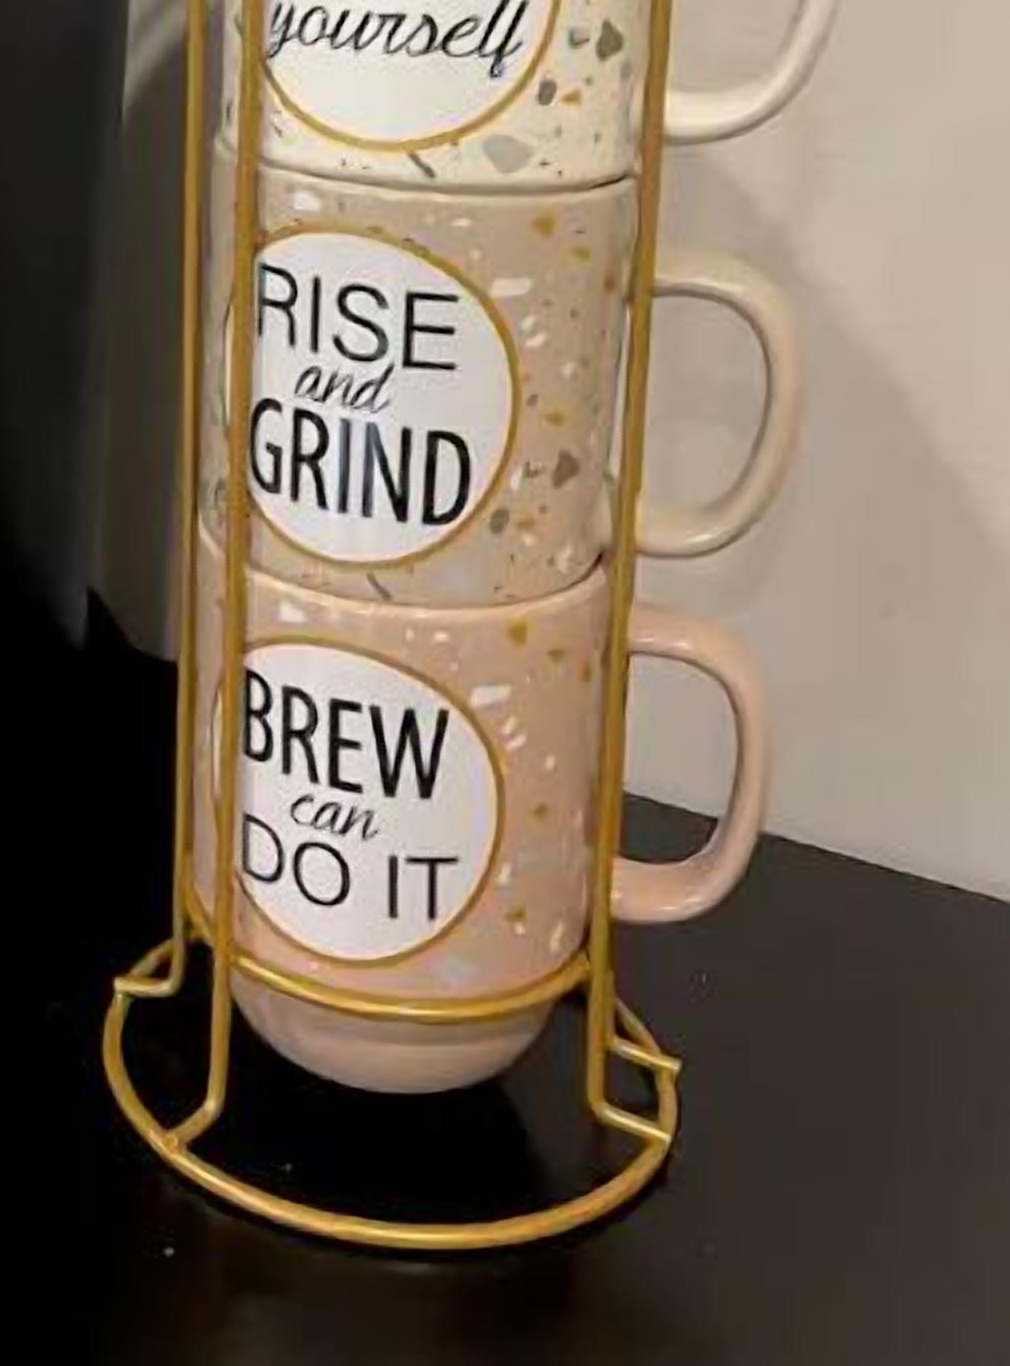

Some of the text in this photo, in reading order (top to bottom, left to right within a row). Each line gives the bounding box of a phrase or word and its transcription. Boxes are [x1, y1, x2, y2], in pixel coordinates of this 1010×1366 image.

[257, 262, 460, 371] RISE
[294, 362, 395, 414] and
[250, 398, 472, 526] GRIND
[243, 668, 450, 800] BREW
[242, 811, 460, 921] DO IT
[290, 794, 380, 841] can
